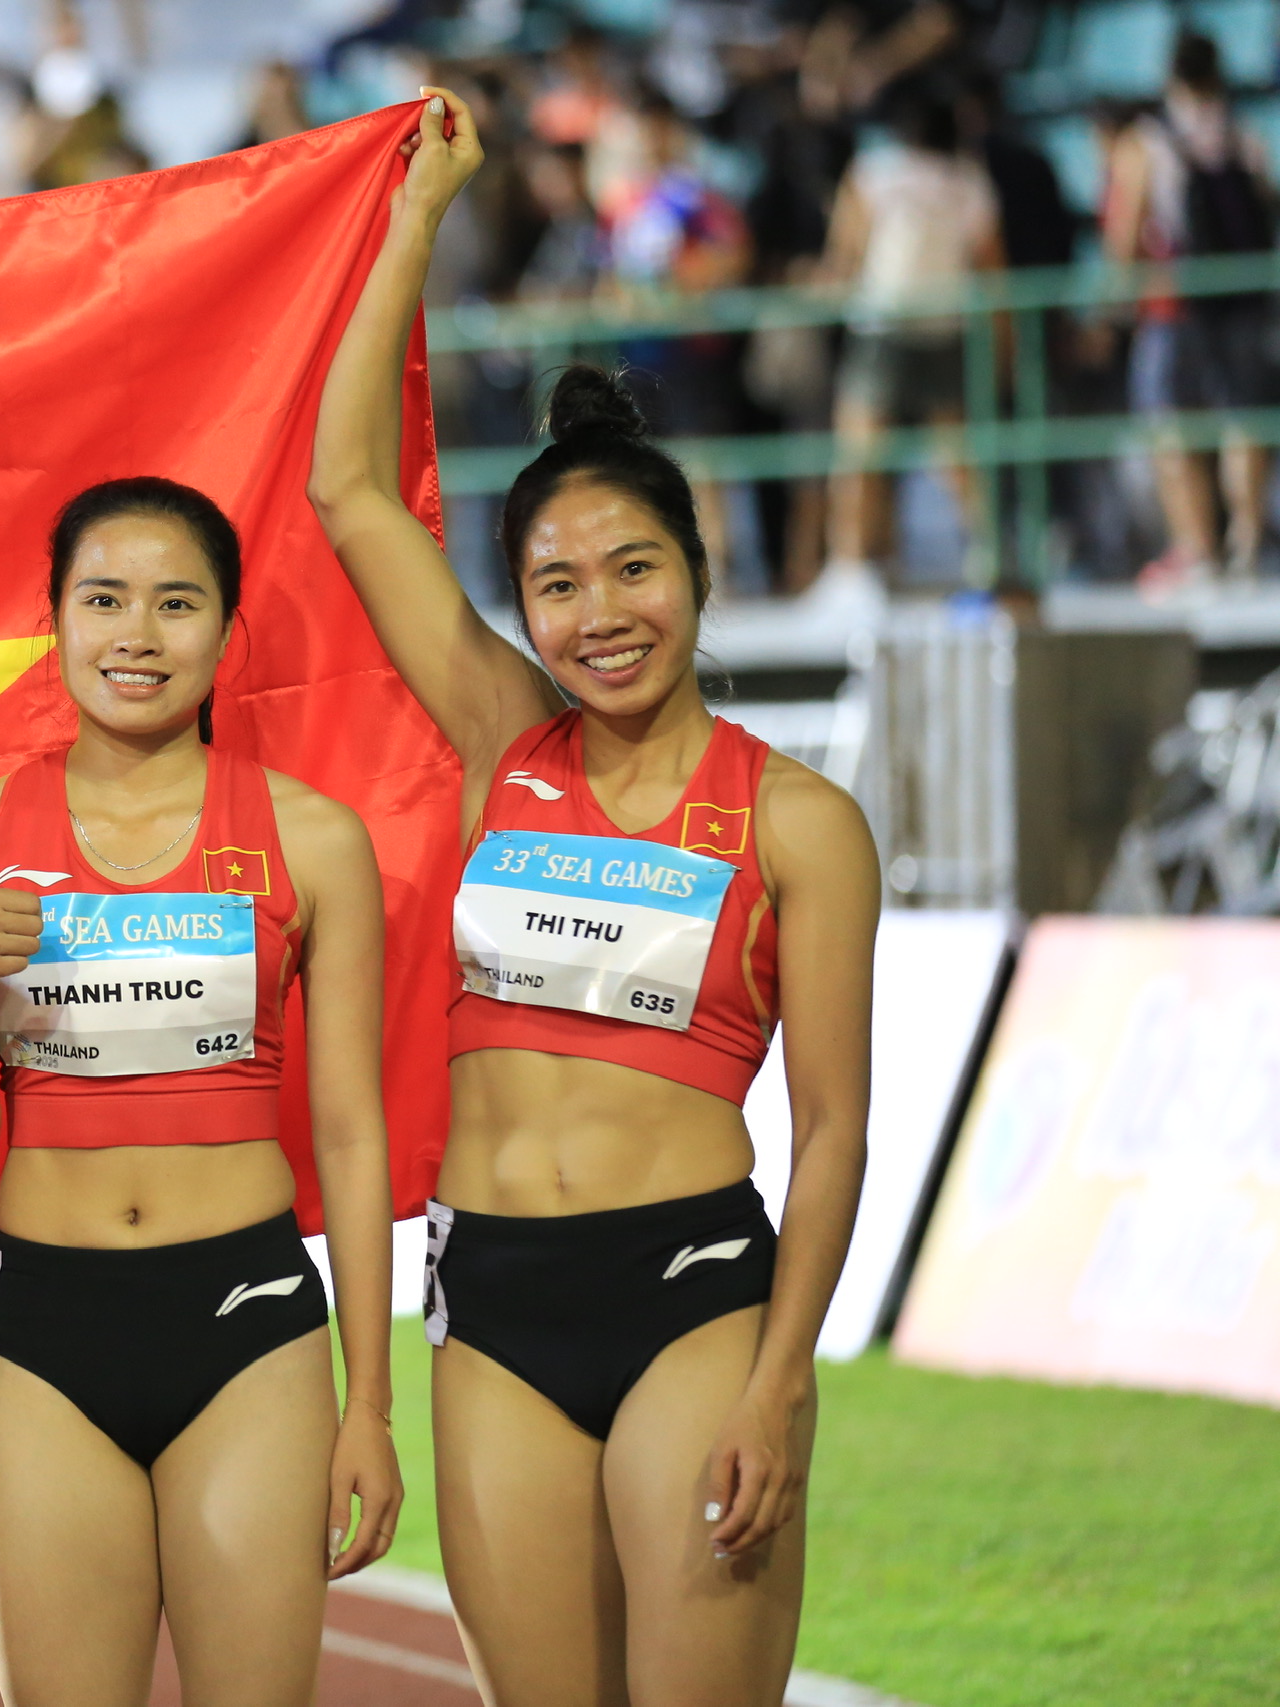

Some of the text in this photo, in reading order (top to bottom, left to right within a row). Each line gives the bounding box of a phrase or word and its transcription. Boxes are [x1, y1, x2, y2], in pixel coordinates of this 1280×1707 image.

[493, 844, 697, 899] 33rd SEA GAMES
[59, 915, 113, 945] SEA
[122, 914, 223, 942] GAMES
[525, 912, 623, 943] THI THU
[28, 979, 204, 1006] THANH TRUC
[630, 990, 675, 1014] 635
[33, 1042, 99, 1059] THAILAND
[196, 1034, 238, 1055] 642
